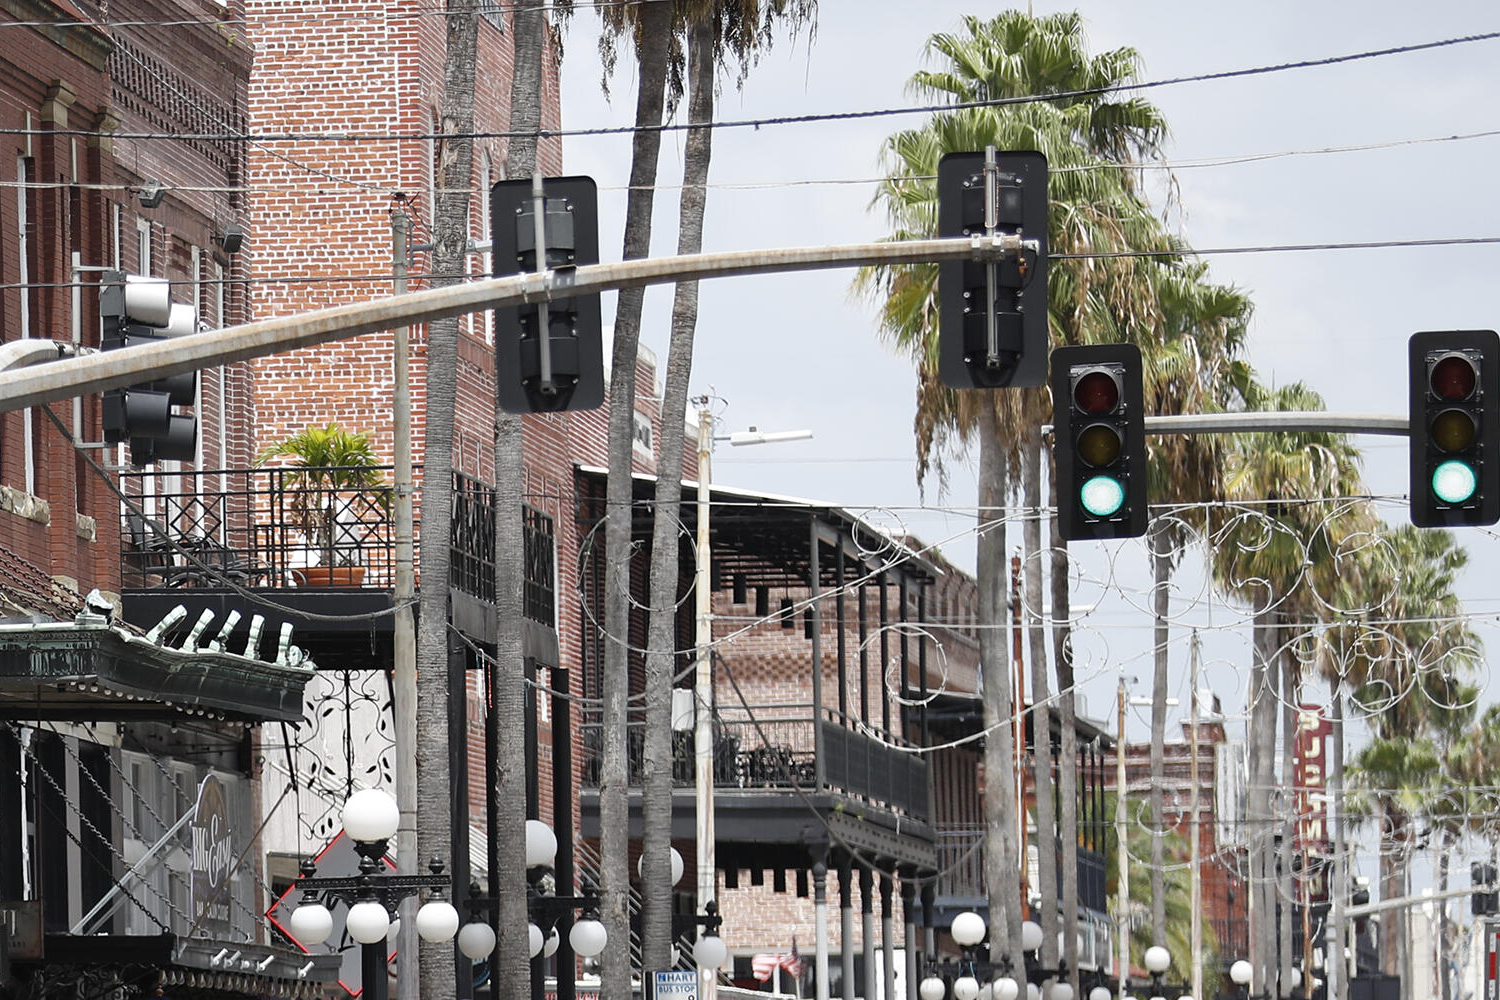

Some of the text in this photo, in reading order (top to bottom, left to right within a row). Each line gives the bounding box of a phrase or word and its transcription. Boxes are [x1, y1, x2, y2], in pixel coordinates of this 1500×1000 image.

[192, 814, 231, 888] BIG Easy
[668, 973, 693, 982] HART
